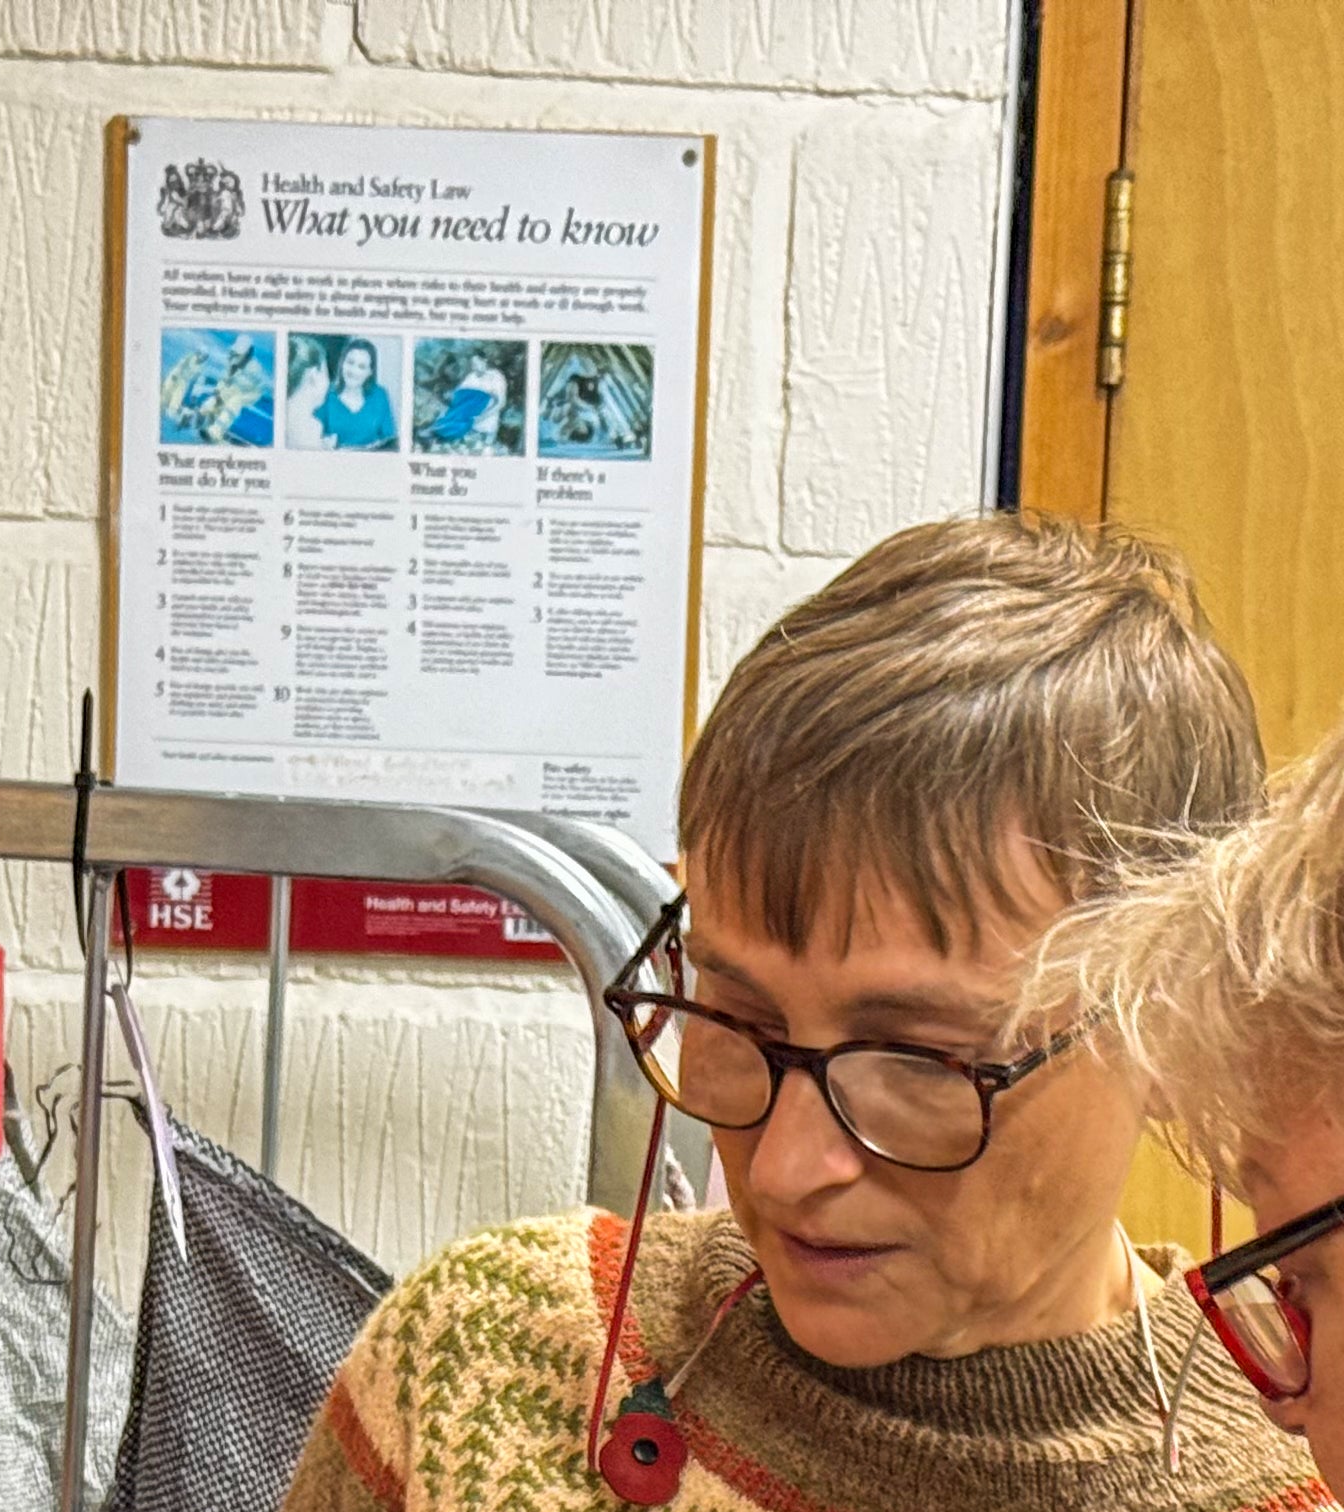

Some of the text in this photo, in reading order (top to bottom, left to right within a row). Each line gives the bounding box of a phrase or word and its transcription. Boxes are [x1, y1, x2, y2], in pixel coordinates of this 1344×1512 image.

[262, 172, 471, 203] Health and Safety Law
[261, 197, 660, 247] What you need to know
[228, 271, 251, 282] have
[490, 281, 523, 293] health
[526, 282, 546, 294] and
[222, 285, 256, 298] Health
[261, 289, 281, 300] and
[163, 299, 188, 311] Your
[191, 301, 239, 314] employer
[334, 305, 366, 317] health
[369, 307, 389, 319] and
[157, 452, 267, 475] What employers
[159, 472, 271, 492] must do for you
[408, 462, 477, 484] What you
[536, 466, 548, 482] If
[551, 467, 593, 484] there's
[410, 481, 468, 497] must do
[536, 487, 593, 504] problem
[160, 504, 167, 522] 1
[283, 512, 294, 526] 6
[411, 514, 418, 531] 1
[283, 535, 294, 552] 7
[156, 549, 167, 566] 2
[408, 558, 418, 576] 2
[533, 571, 543, 589] 2
[156, 592, 166, 610] 3
[280, 624, 292, 641] 9
[154, 680, 165, 698] 5
[272, 685, 292, 703] 10
[366, 896, 498, 919] Health and Safety
[149, 904, 213, 931] HSE
